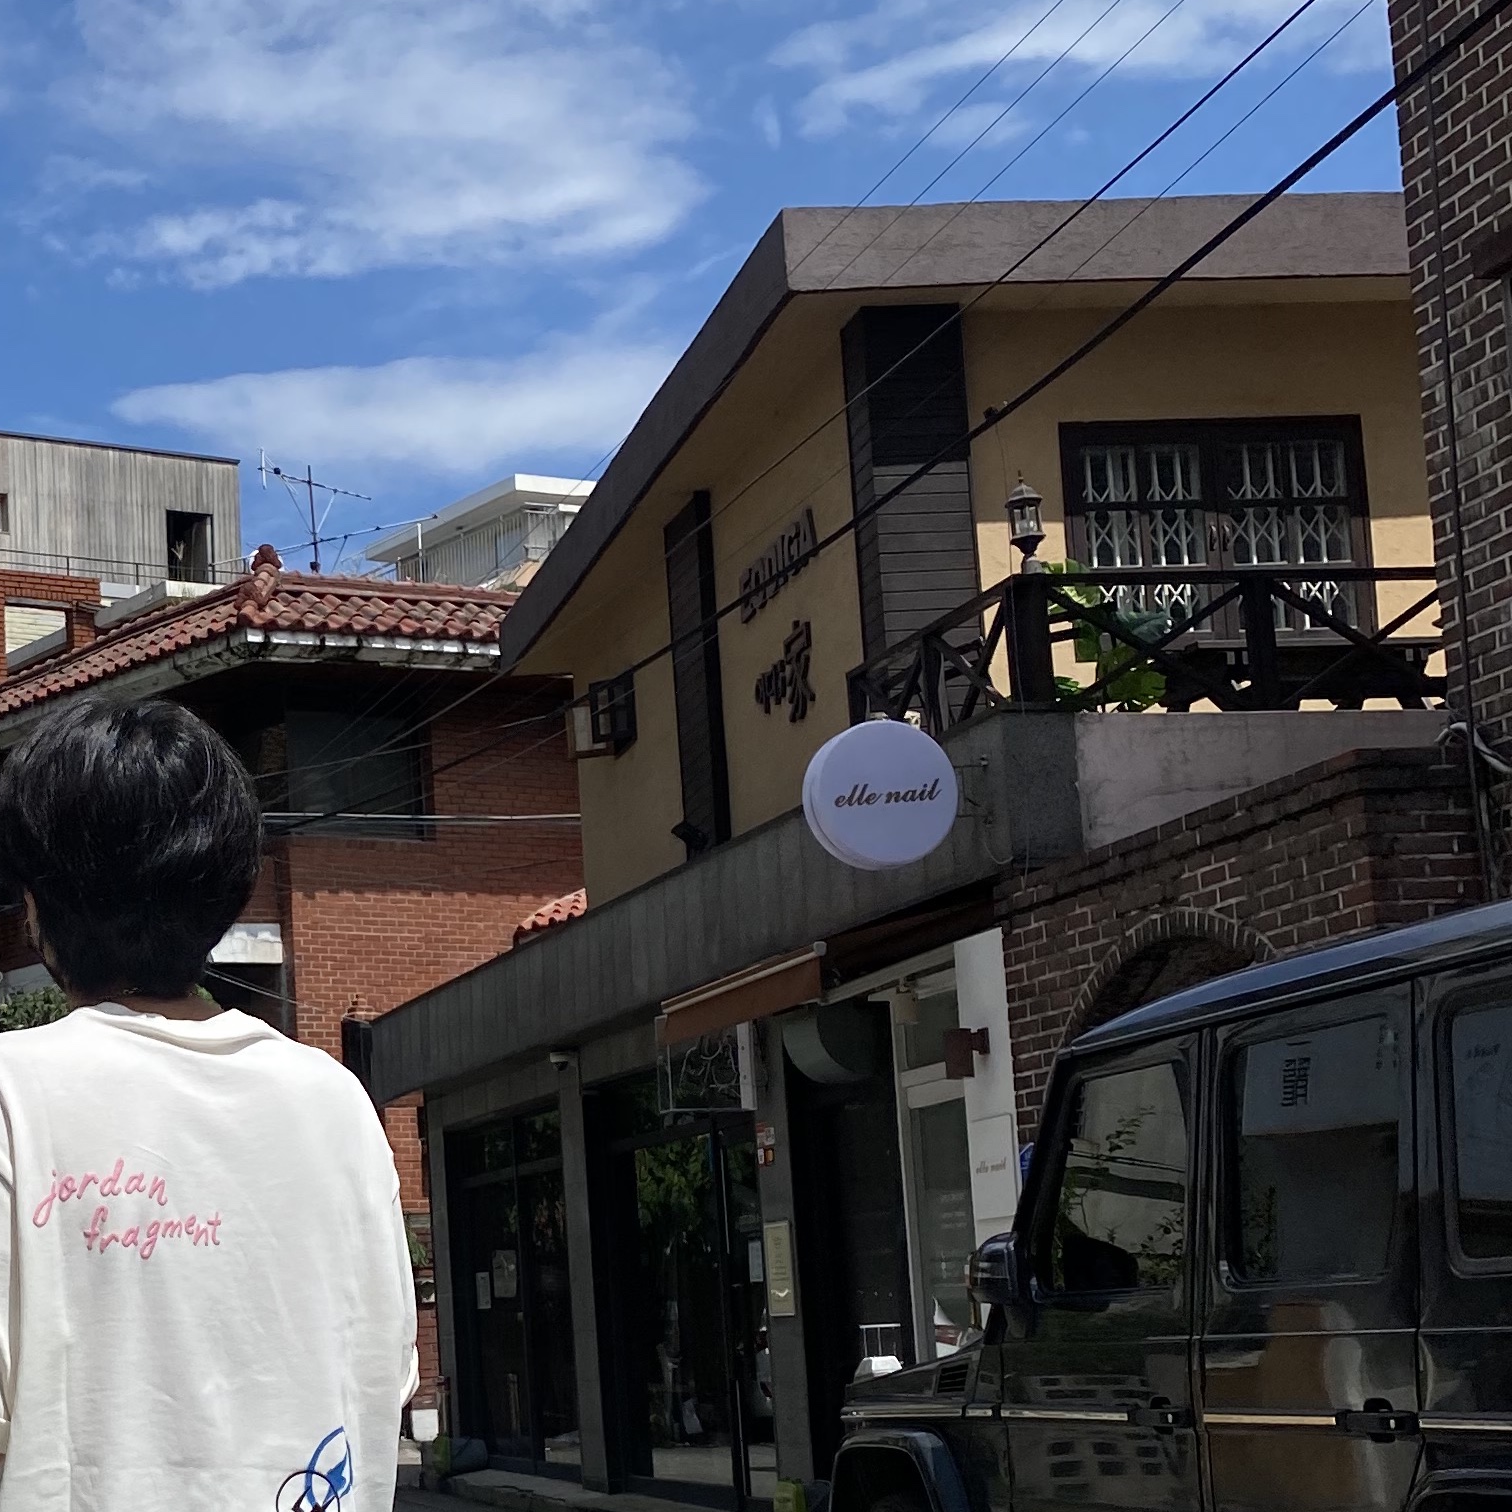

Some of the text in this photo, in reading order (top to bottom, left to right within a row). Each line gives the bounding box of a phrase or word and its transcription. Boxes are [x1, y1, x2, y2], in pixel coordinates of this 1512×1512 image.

[834, 778, 943, 809] elle nail
[32, 1157, 168, 1228] jordan
[83, 1205, 222, 1260] fragment
